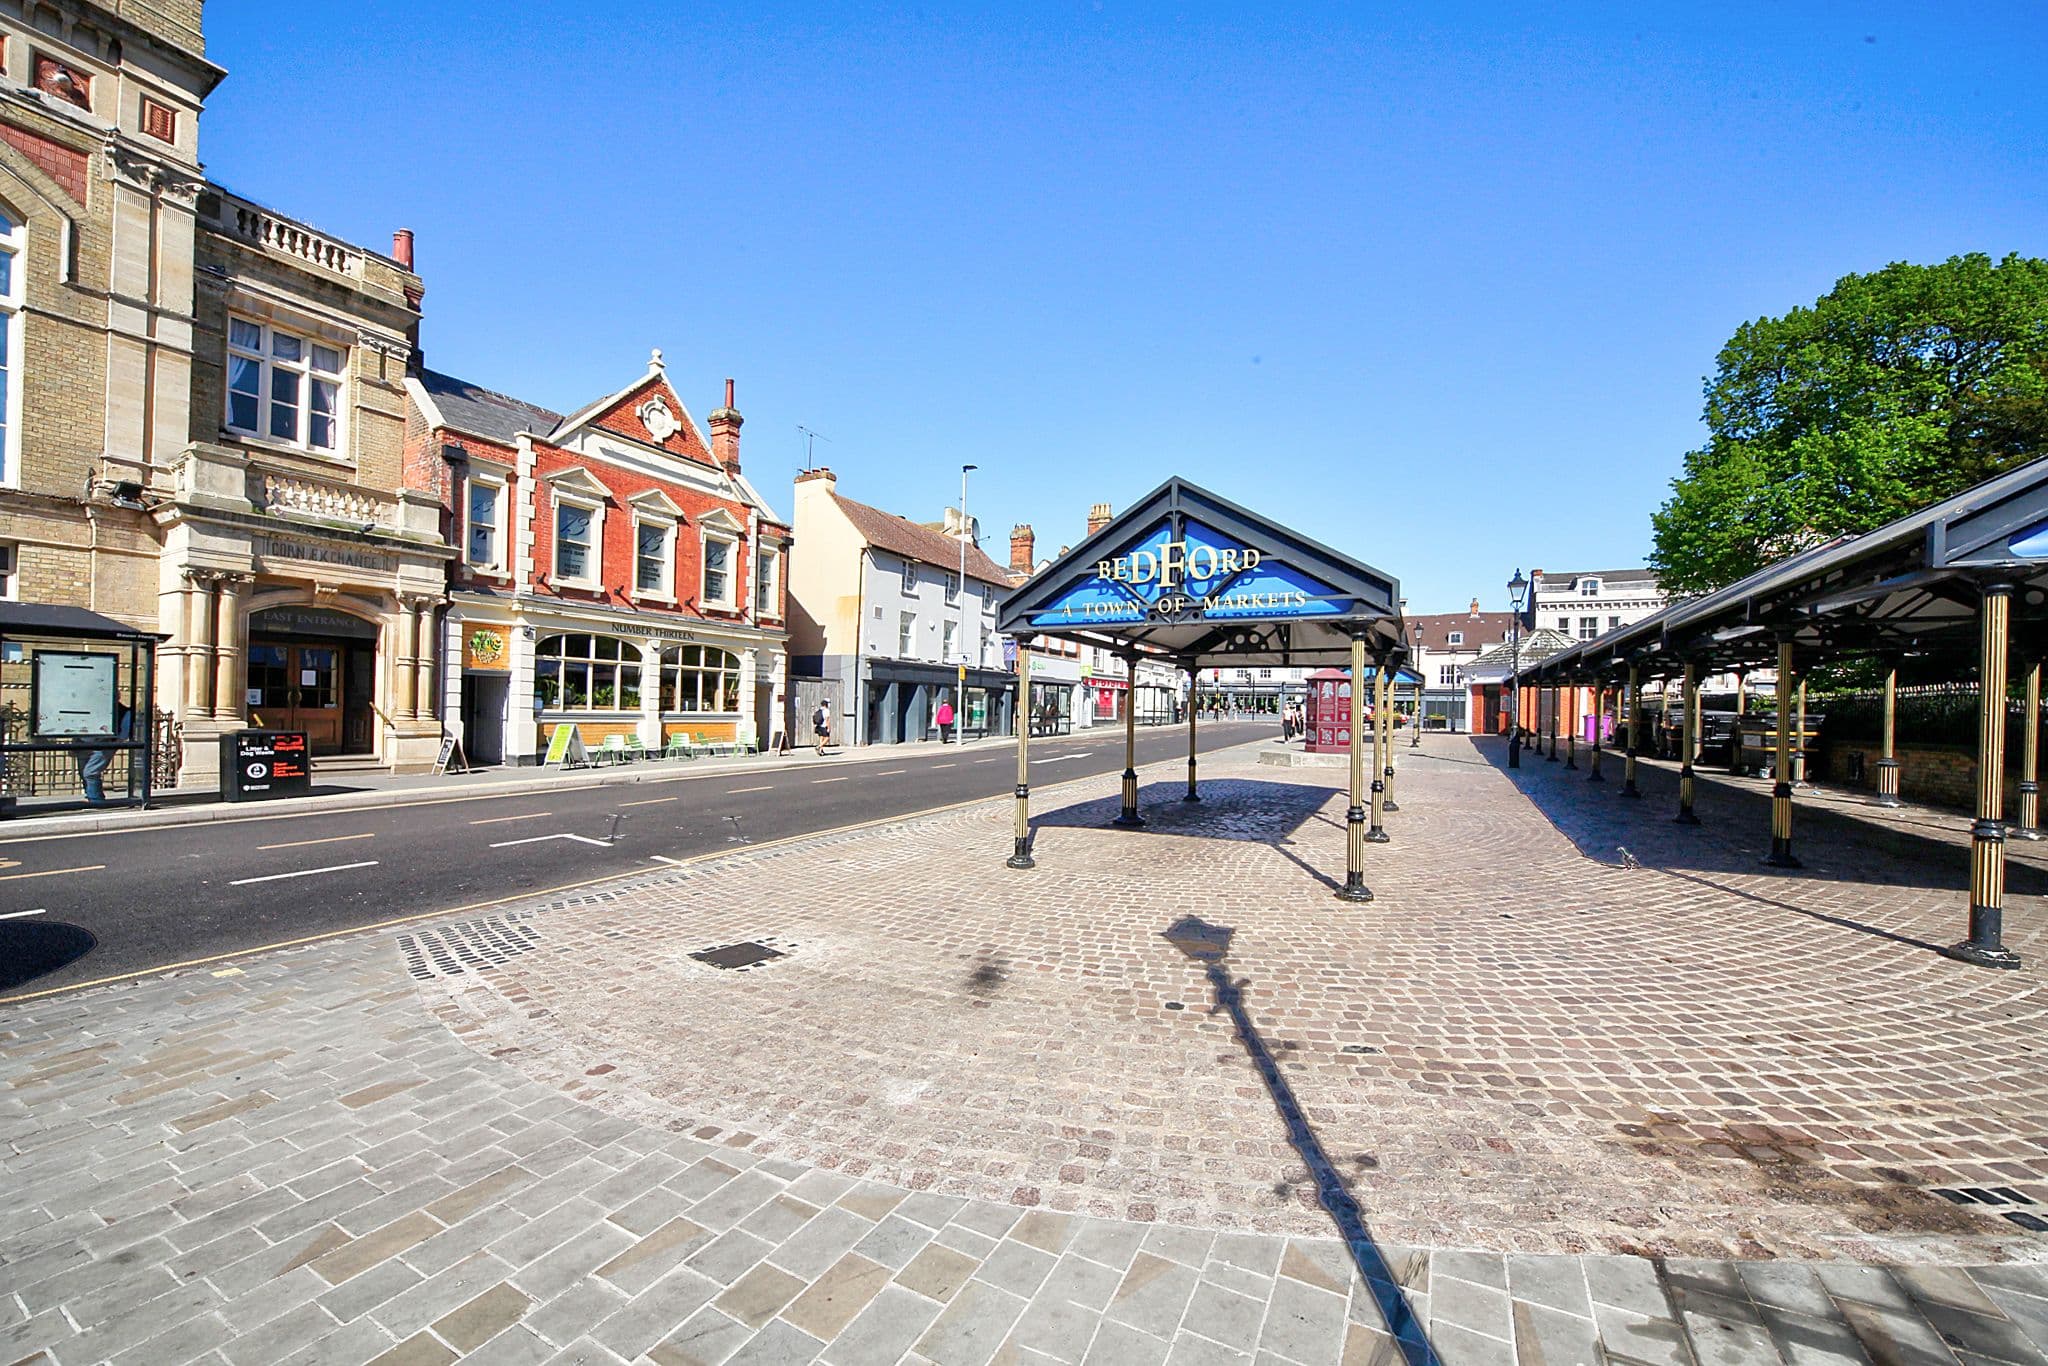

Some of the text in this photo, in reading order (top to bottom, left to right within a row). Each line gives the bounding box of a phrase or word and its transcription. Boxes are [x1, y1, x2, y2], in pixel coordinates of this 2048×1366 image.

[271, 542, 377, 570] CORN EXCHANGE
[1097, 541, 1261, 588] BEDFORD
[1062, 591, 1307, 618] A TOWN OF MARKETS
[263, 611, 359, 628] EAST ENTRANCE
[611, 623, 695, 641] NUMBER THIRTEEN
